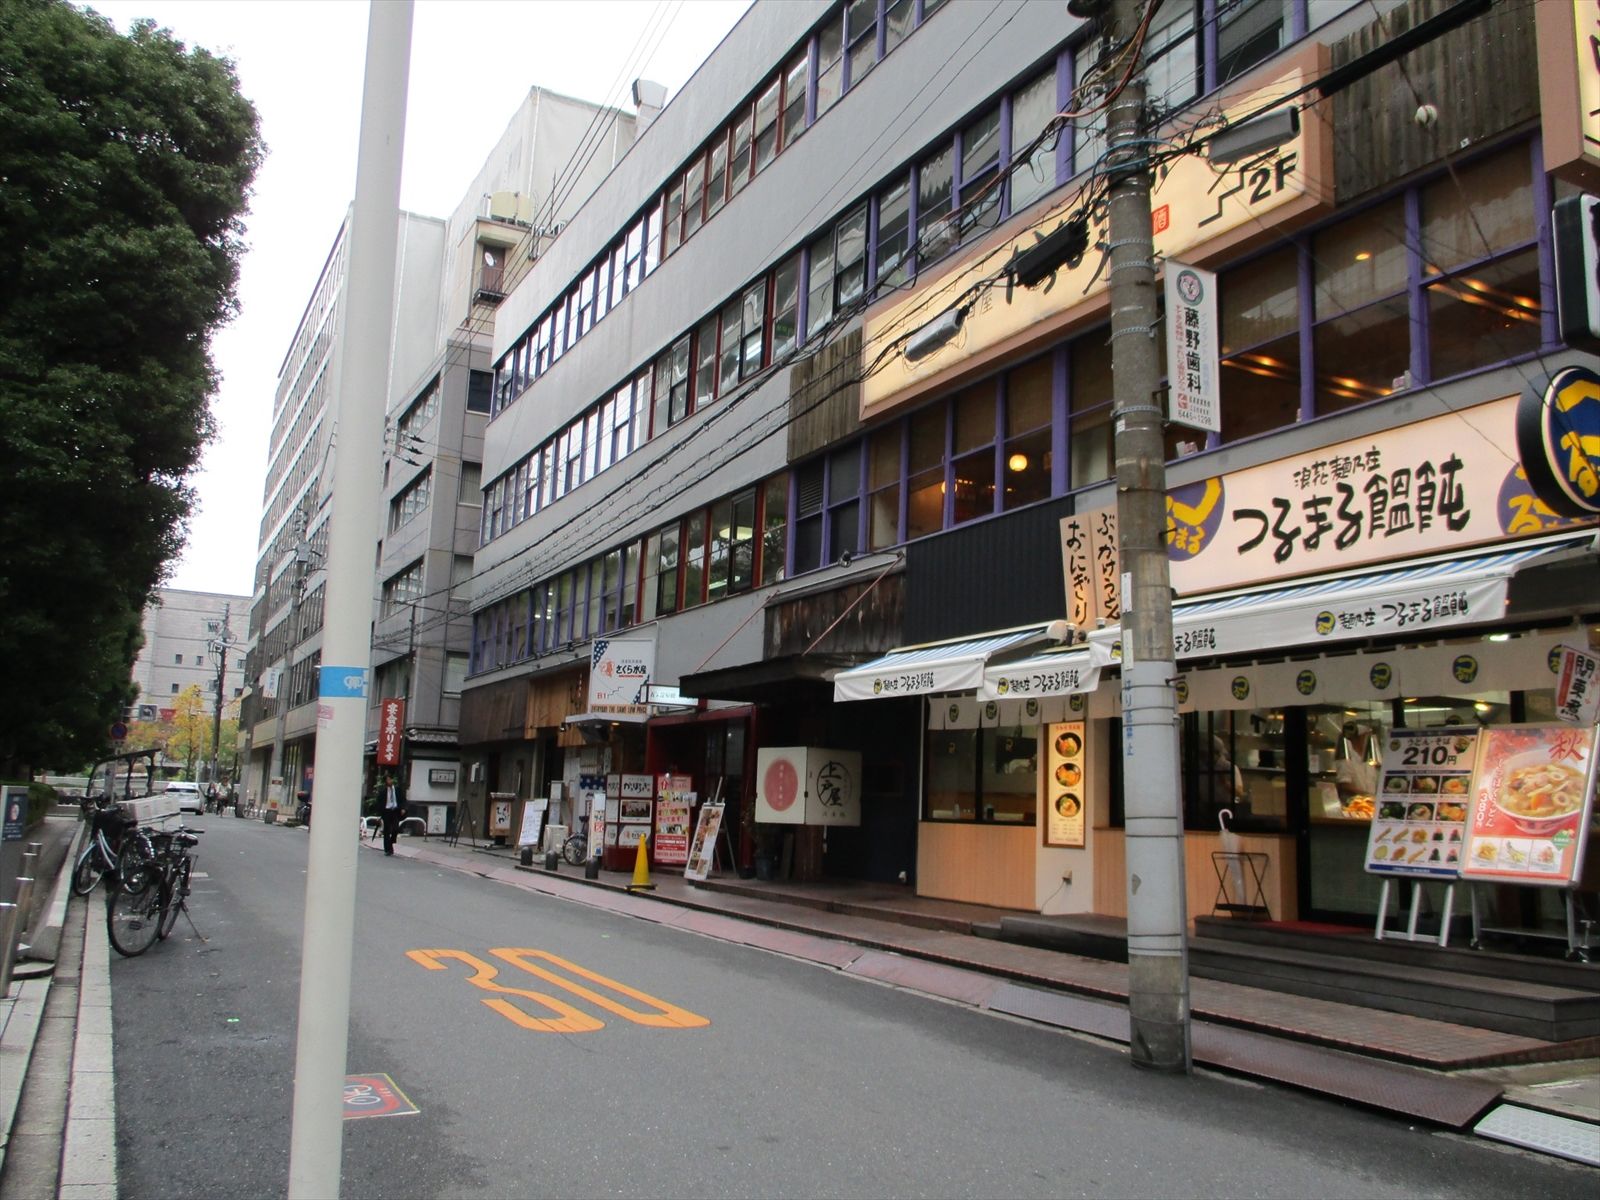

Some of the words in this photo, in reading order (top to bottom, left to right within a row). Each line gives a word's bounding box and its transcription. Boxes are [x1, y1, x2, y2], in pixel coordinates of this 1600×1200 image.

[1248, 153, 1297, 206] 2F
[1184, 306, 1201, 395] 藤野歯科
[1233, 452, 1471, 564] つるまる饂飩
[1067, 520, 1091, 626] おにぎり
[1097, 512, 1121, 621] ぶっかけうどん
[1382, 589, 1470, 627] つるまる饂飩
[615, 664, 647, 675] さくら水産
[384, 702, 399, 762] 宴会承ります
[1402, 745, 1457, 766] 210円
[1548, 732, 1585, 761] 秋
[405, 947, 711, 1033] 30
